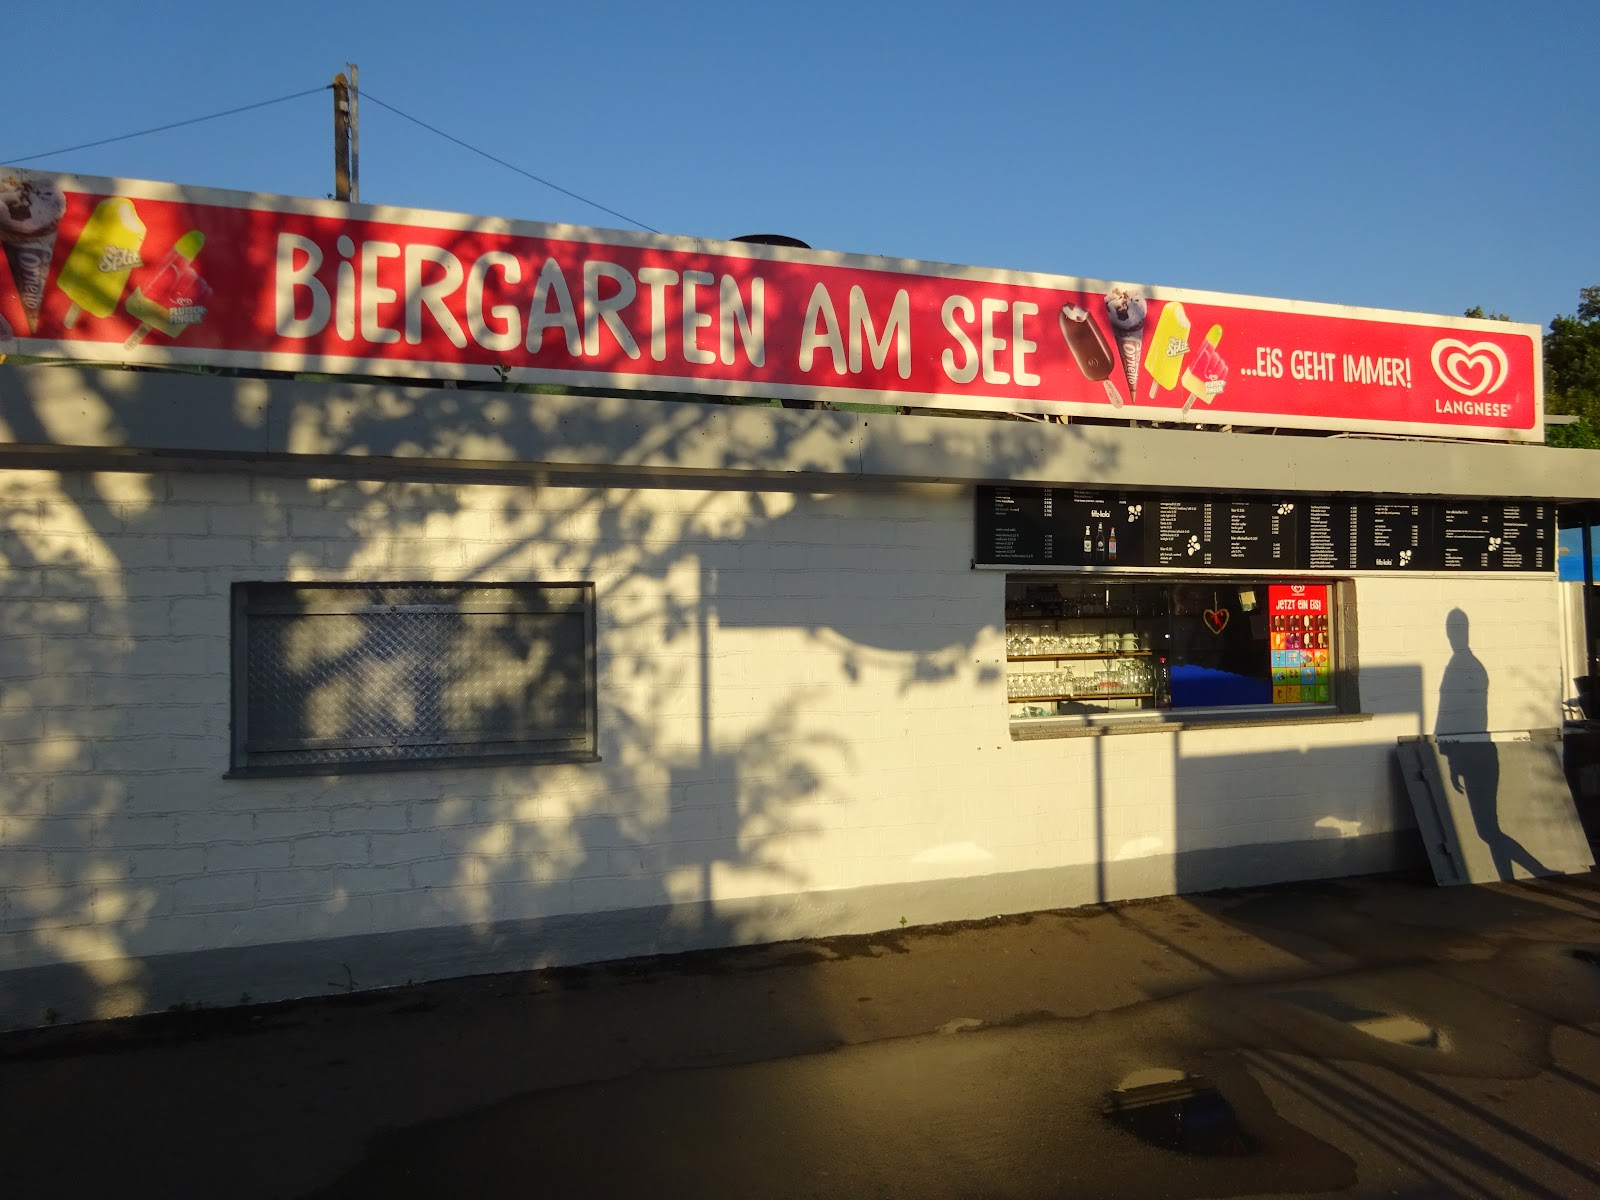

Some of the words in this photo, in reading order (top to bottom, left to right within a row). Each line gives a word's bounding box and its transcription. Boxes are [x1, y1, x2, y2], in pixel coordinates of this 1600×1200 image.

[798, 282, 912, 380] AM
[941, 294, 1041, 387] SEE
[1166, 339, 1190, 357] Split
[1290, 349, 1336, 382] GEHT
[1343, 354, 1412, 389] IMMER!
